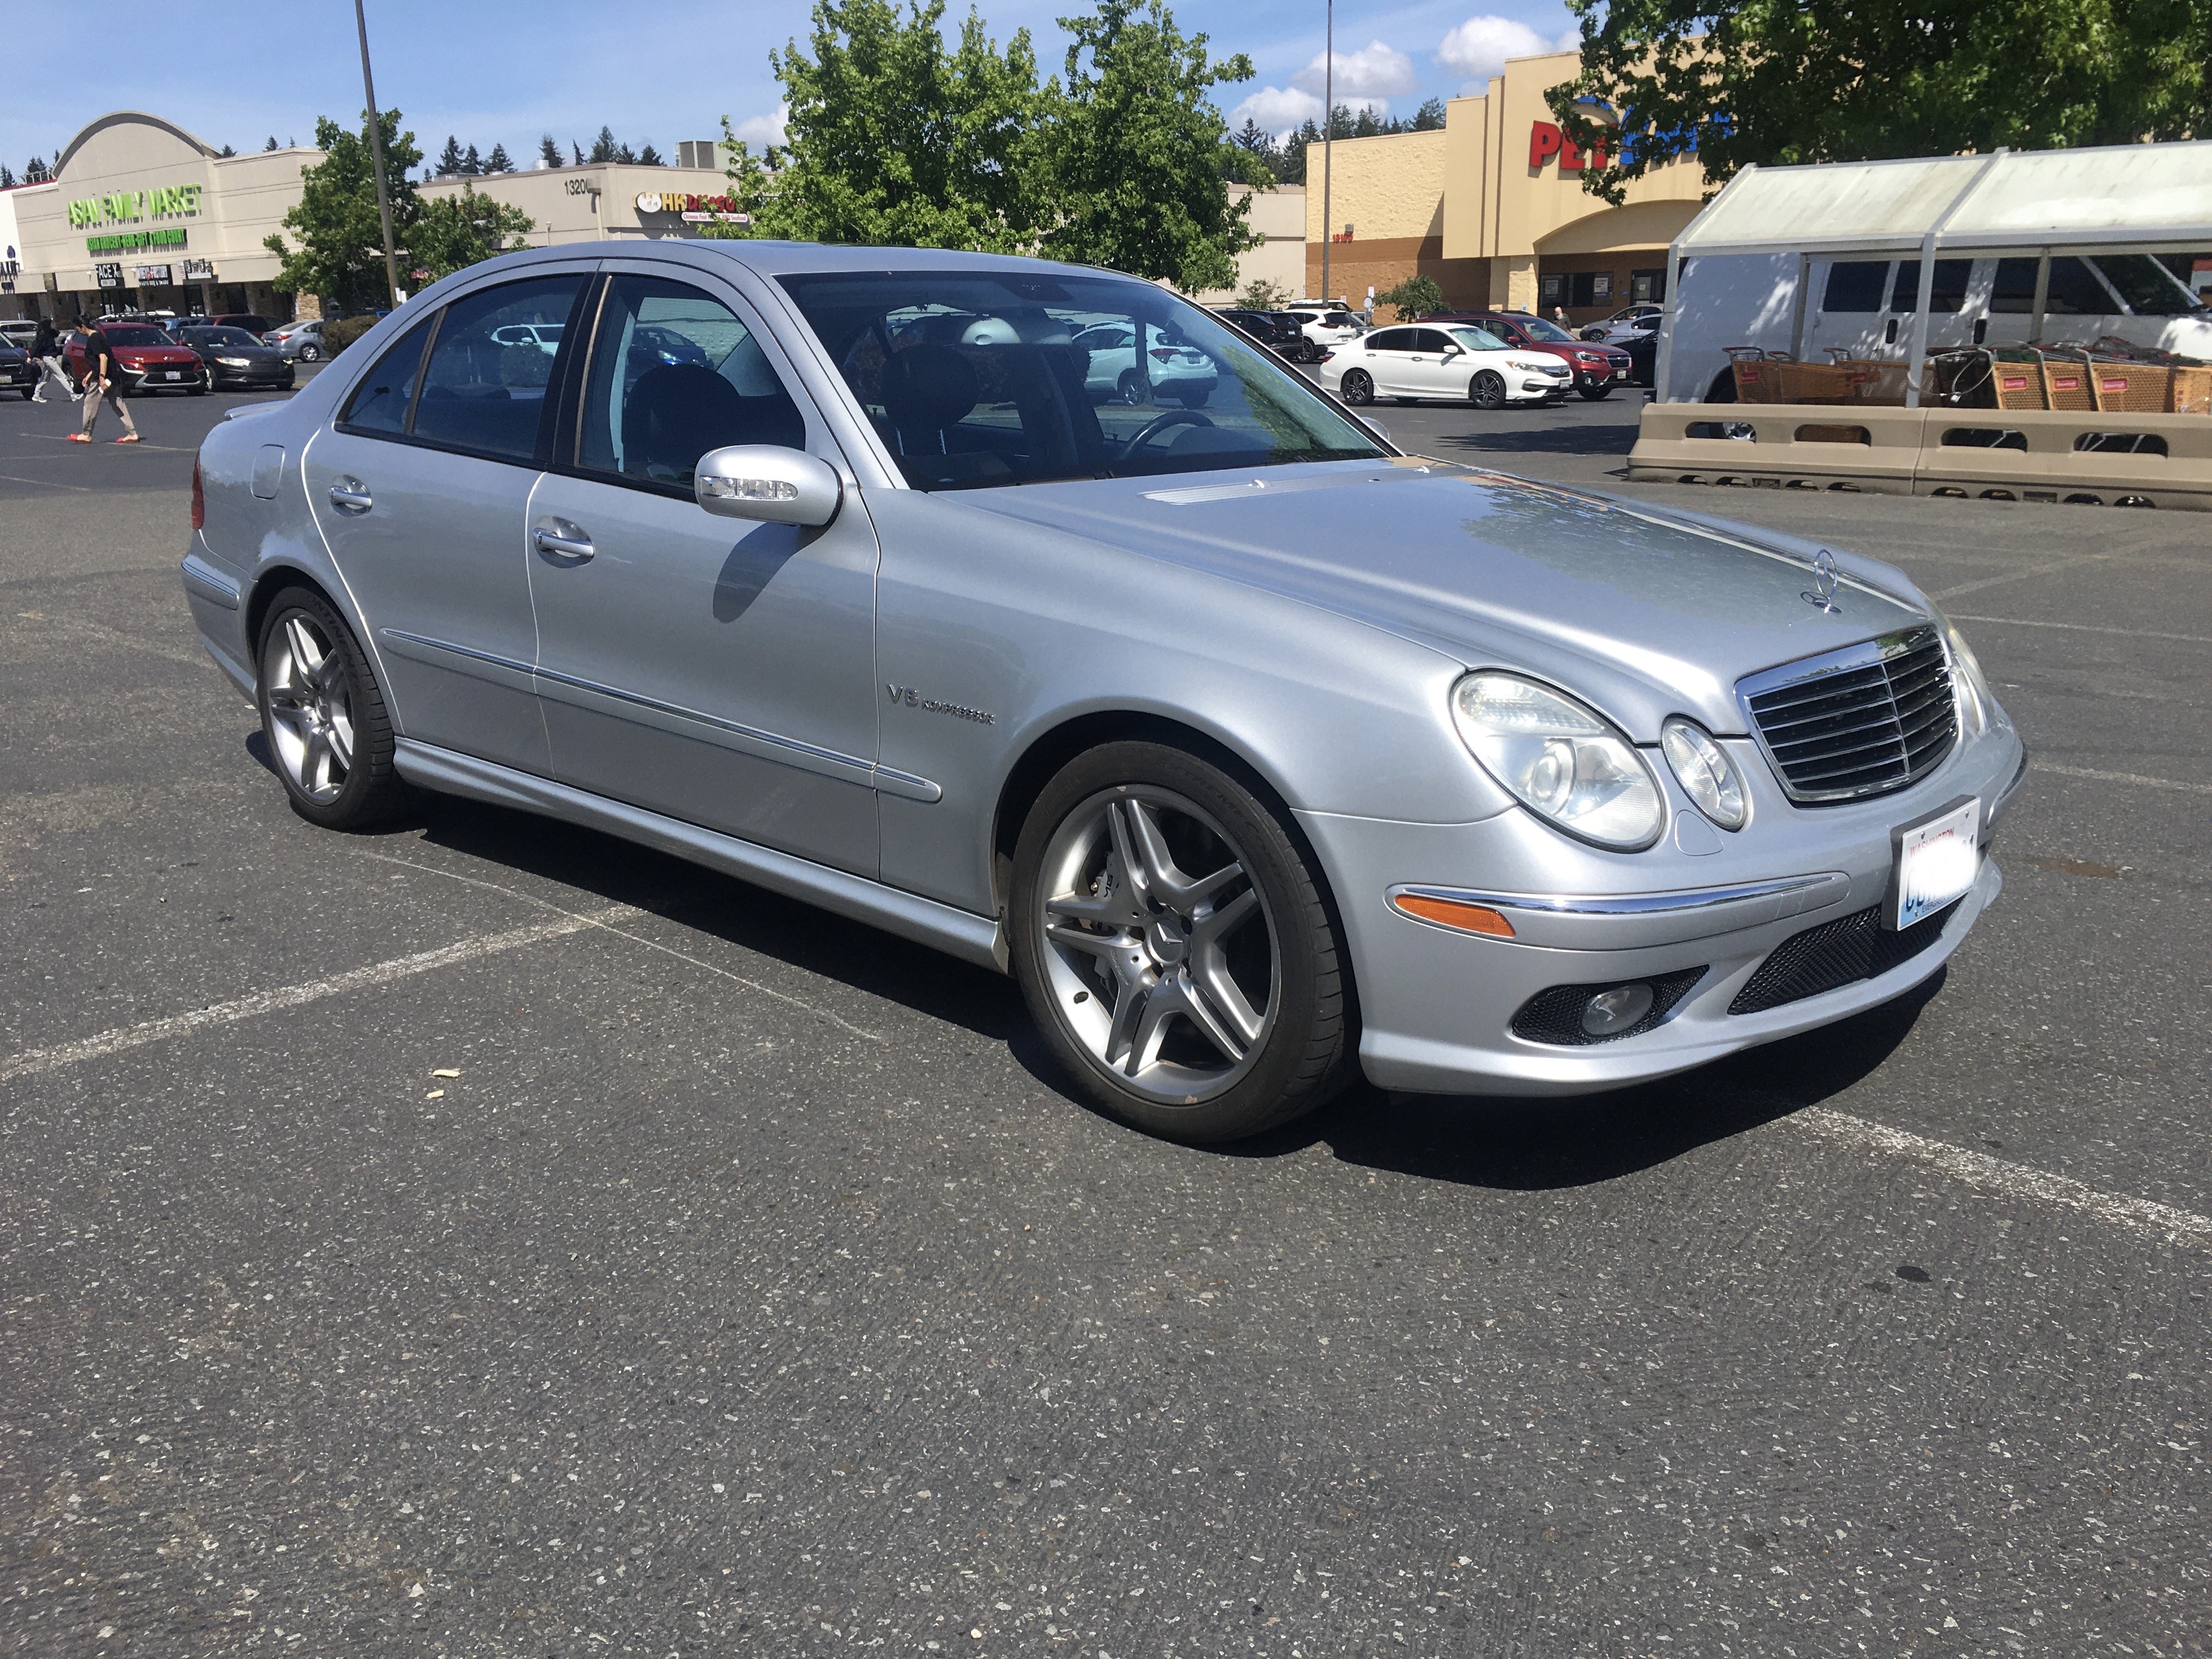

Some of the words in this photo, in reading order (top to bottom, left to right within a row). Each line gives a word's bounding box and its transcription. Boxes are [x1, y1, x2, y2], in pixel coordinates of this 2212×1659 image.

[68, 198, 102, 225] ASIAN
[102, 191, 143, 221] FAMILY
[148, 183, 202, 216] MARKET
[660, 193, 686, 211] HK
[95, 264, 112, 278] FACE
[112, 264, 119, 278] X
[887, 683, 918, 708] V8
[922, 698, 996, 726] KOMPRESSOR
[1910, 827, 1955, 858] WASHINGTON
